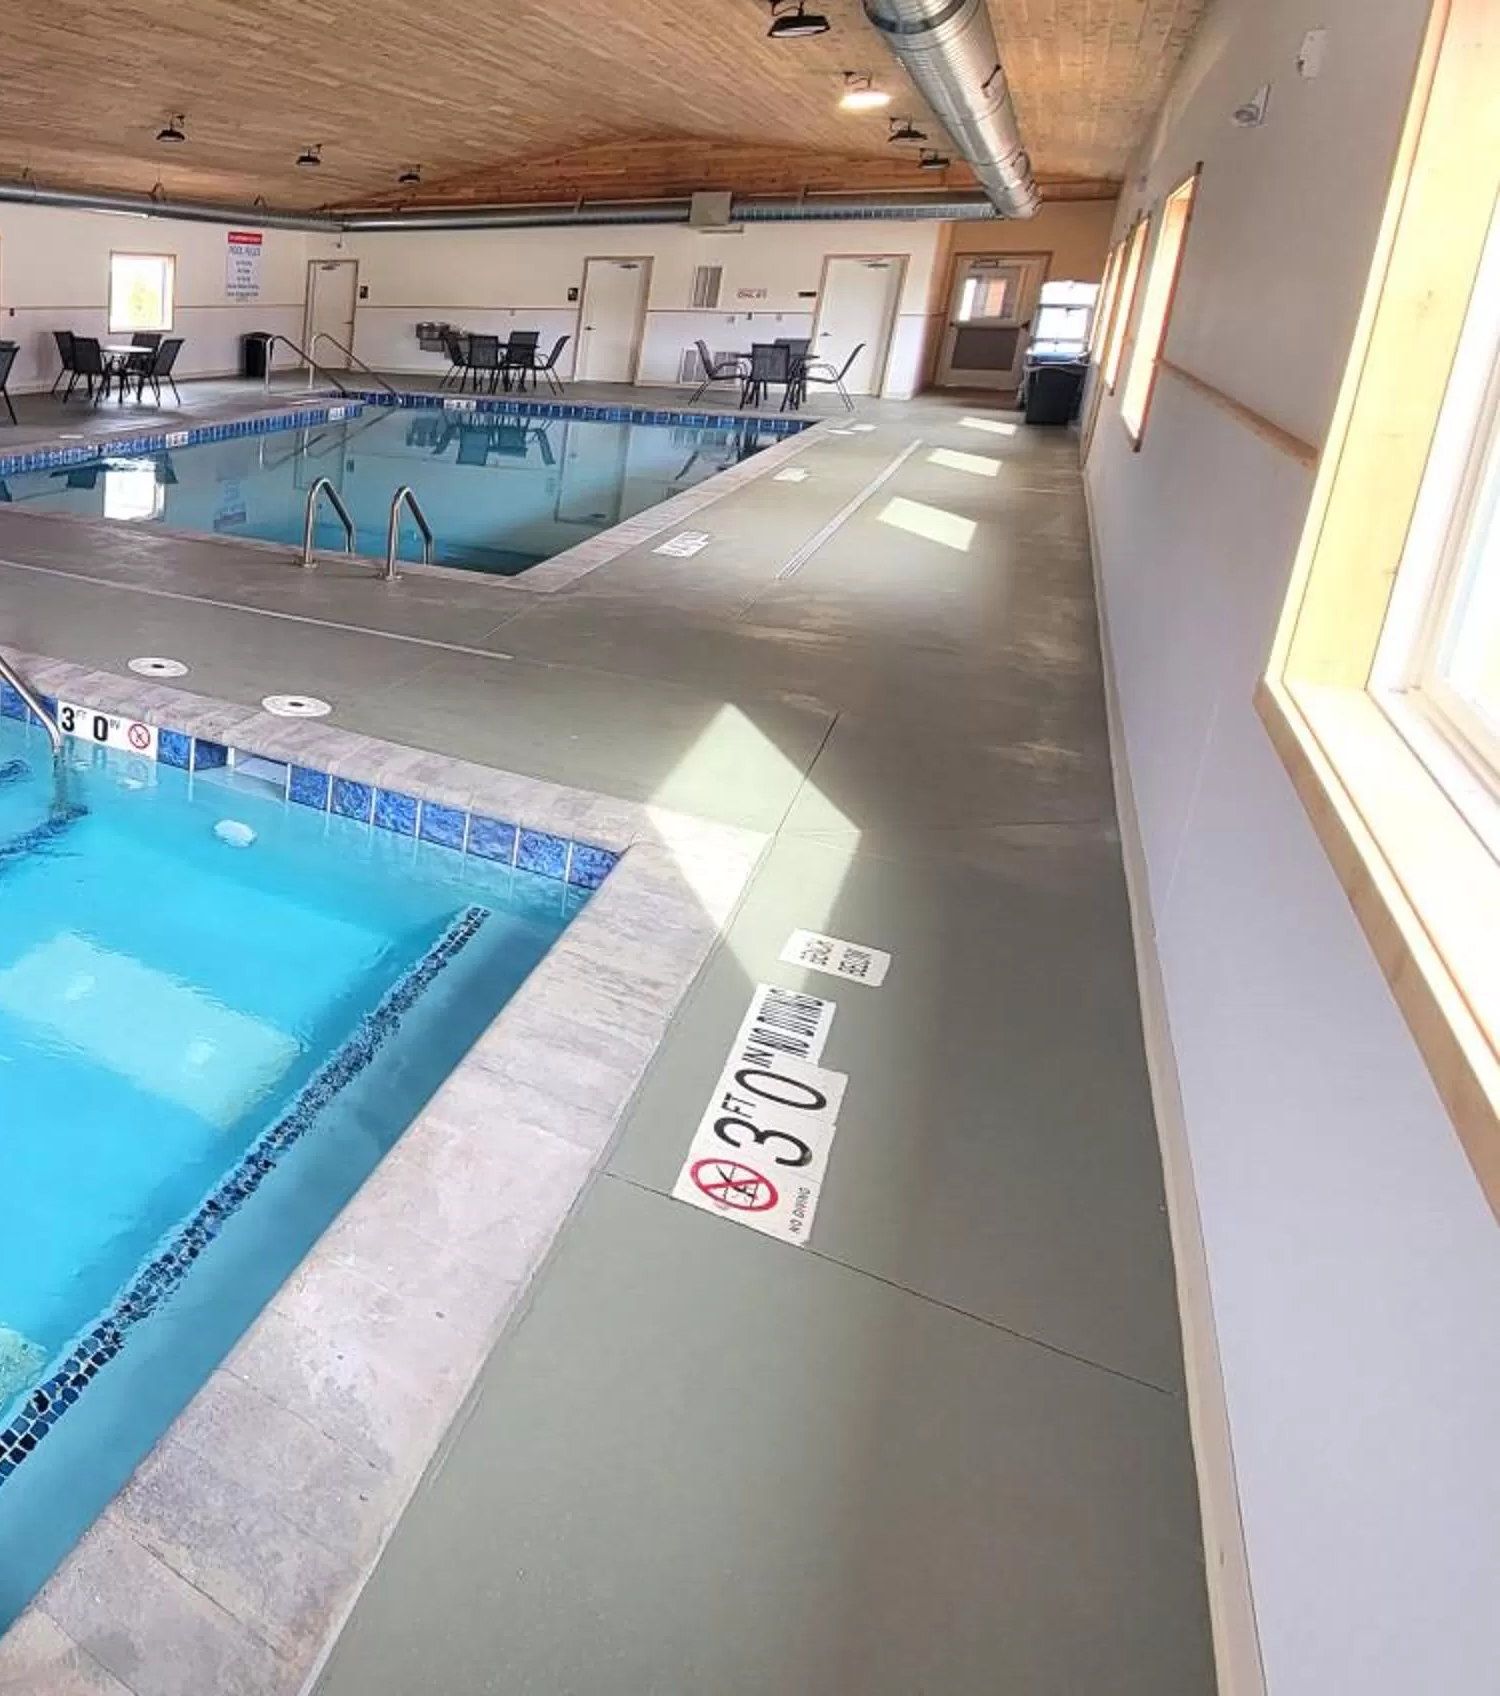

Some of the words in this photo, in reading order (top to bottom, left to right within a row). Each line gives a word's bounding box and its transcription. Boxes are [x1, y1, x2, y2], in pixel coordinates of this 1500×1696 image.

[61, 706, 75, 732] 3
[93, 715, 109, 742] 0
[757, 987, 825, 1037] DIVING
[742, 1045, 775, 1069] IN
[748, 1026, 811, 1058] NO
[721, 1092, 756, 1119] FT
[734, 1068, 827, 1111] 0
[713, 1116, 812, 1167] 3
[794, 1186, 812, 1218] DIVING
[788, 1215, 804, 1234] NO
